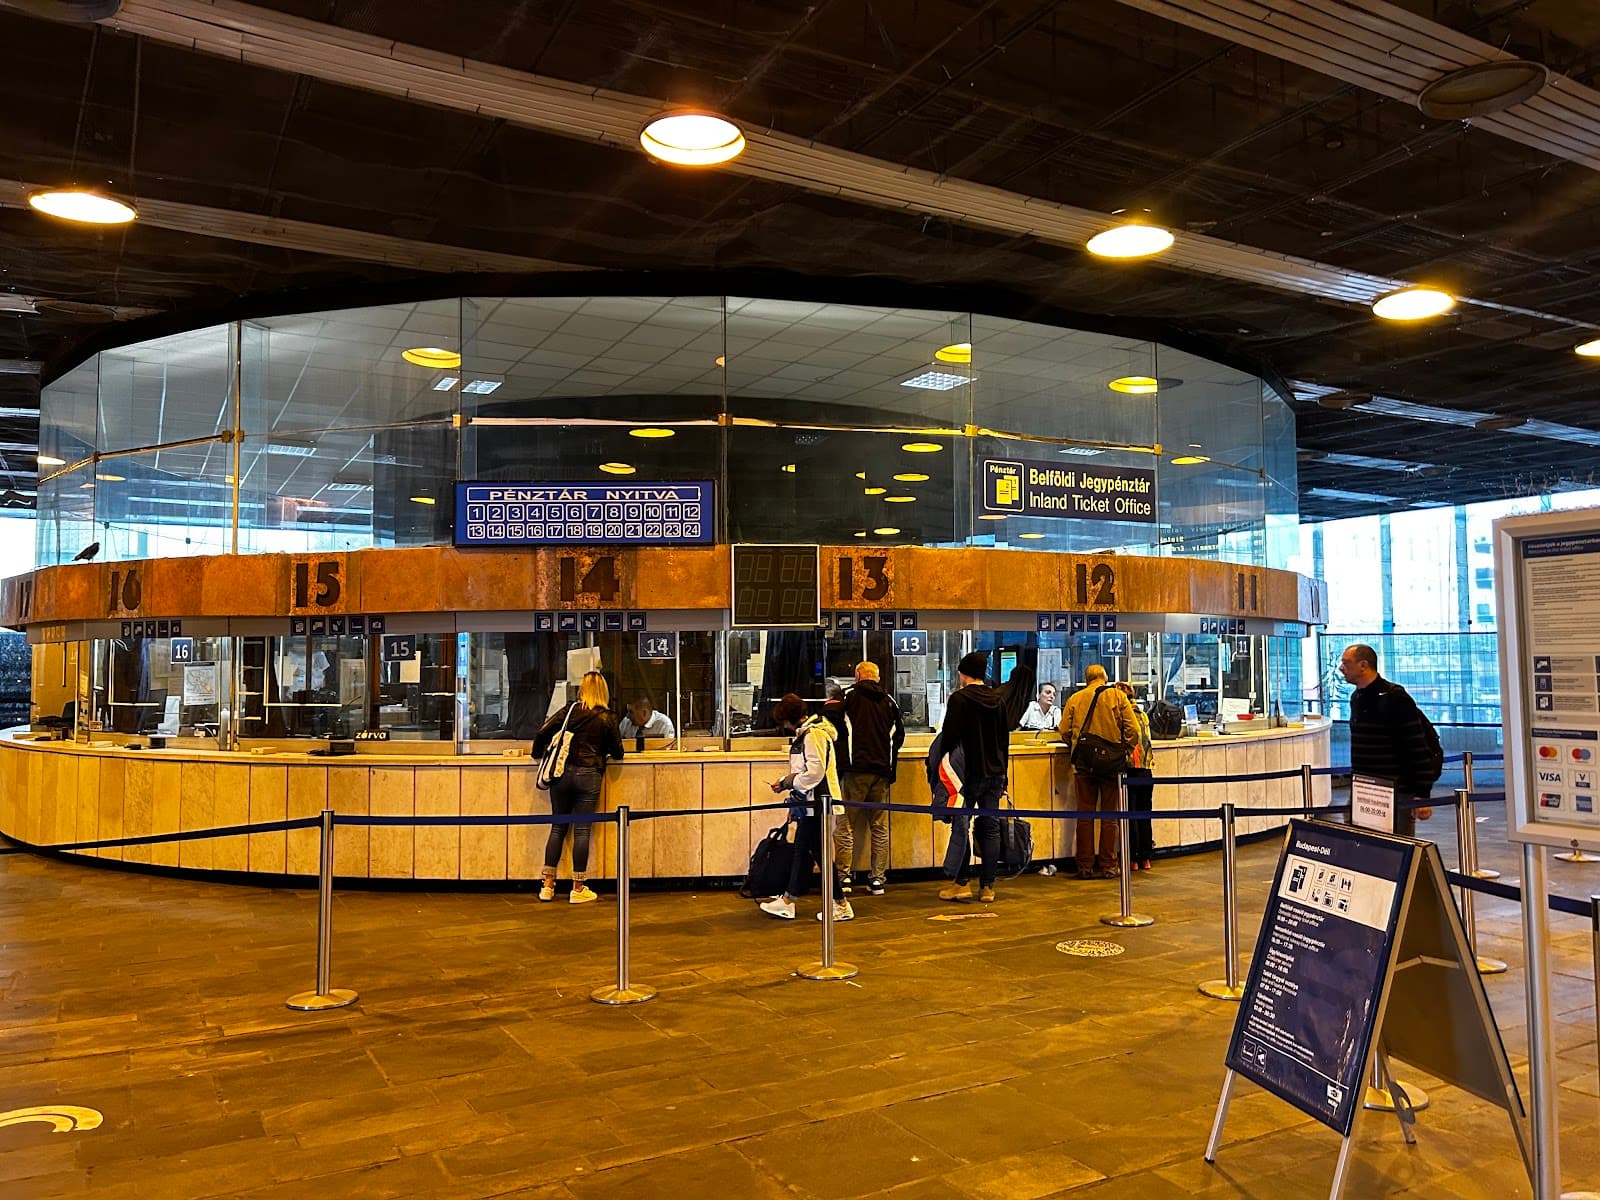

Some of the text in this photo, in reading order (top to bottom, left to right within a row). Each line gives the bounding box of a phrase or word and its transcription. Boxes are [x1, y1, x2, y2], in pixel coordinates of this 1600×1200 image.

[989, 464, 1017, 475] Pénztár
[1029, 468, 1151, 494] Belföldi Jegypénztár
[489, 488, 679, 500] PÉNZTÁR NYITVA
[1029, 491, 1151, 515] Inland Ticket Office
[472, 507, 699, 519] 1 2 3 4 5 6 7 8 9 10 11 12
[470, 525, 698, 537] 13 14 15 16 17 18 19 20 21 22 23 24
[295, 562, 341, 608] 15
[559, 556, 620, 602] 14
[838, 556, 890, 601] 13
[1076, 563, 1115, 605] 12
[110, 569, 142, 611] 16
[1238, 573, 1257, 610] 11
[19, 579, 32, 618] 17
[1310, 585, 1320, 618] 10
[175, 644, 189, 659] 16
[390, 641, 410, 657] 15
[647, 638, 669, 655] 14
[900, 636, 920, 652] 13
[1107, 640, 1122, 653] 12
[1238, 641, 1248, 654] 11
[355, 730, 387, 739] zárva
[1539, 771, 1561, 782] VISA
